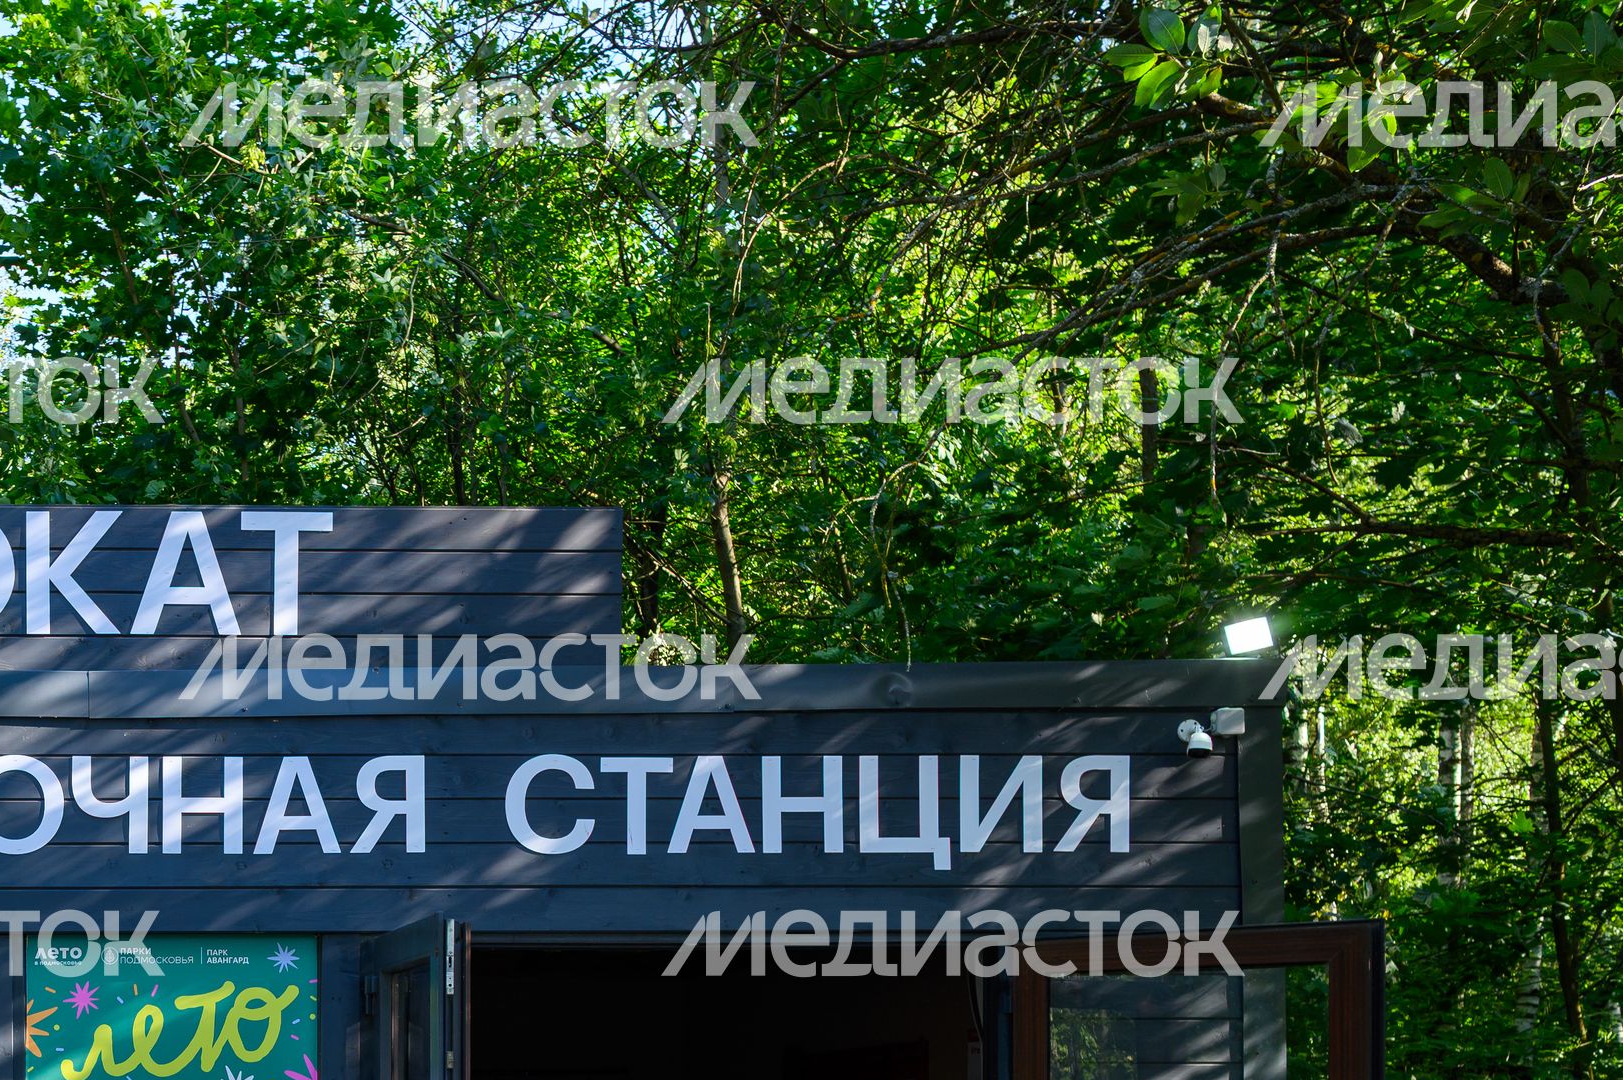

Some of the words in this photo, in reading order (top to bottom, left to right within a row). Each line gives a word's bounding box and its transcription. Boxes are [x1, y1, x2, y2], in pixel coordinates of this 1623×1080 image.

[505, 755, 1131, 872] СТАНЦИЯ
[35, 946, 83, 960] лето
[119, 948, 151, 956] ПАРКИ
[119, 956, 194, 965] ПОДМОСКОВЬЯ
[207, 957, 250, 965] АВАНГАРД
